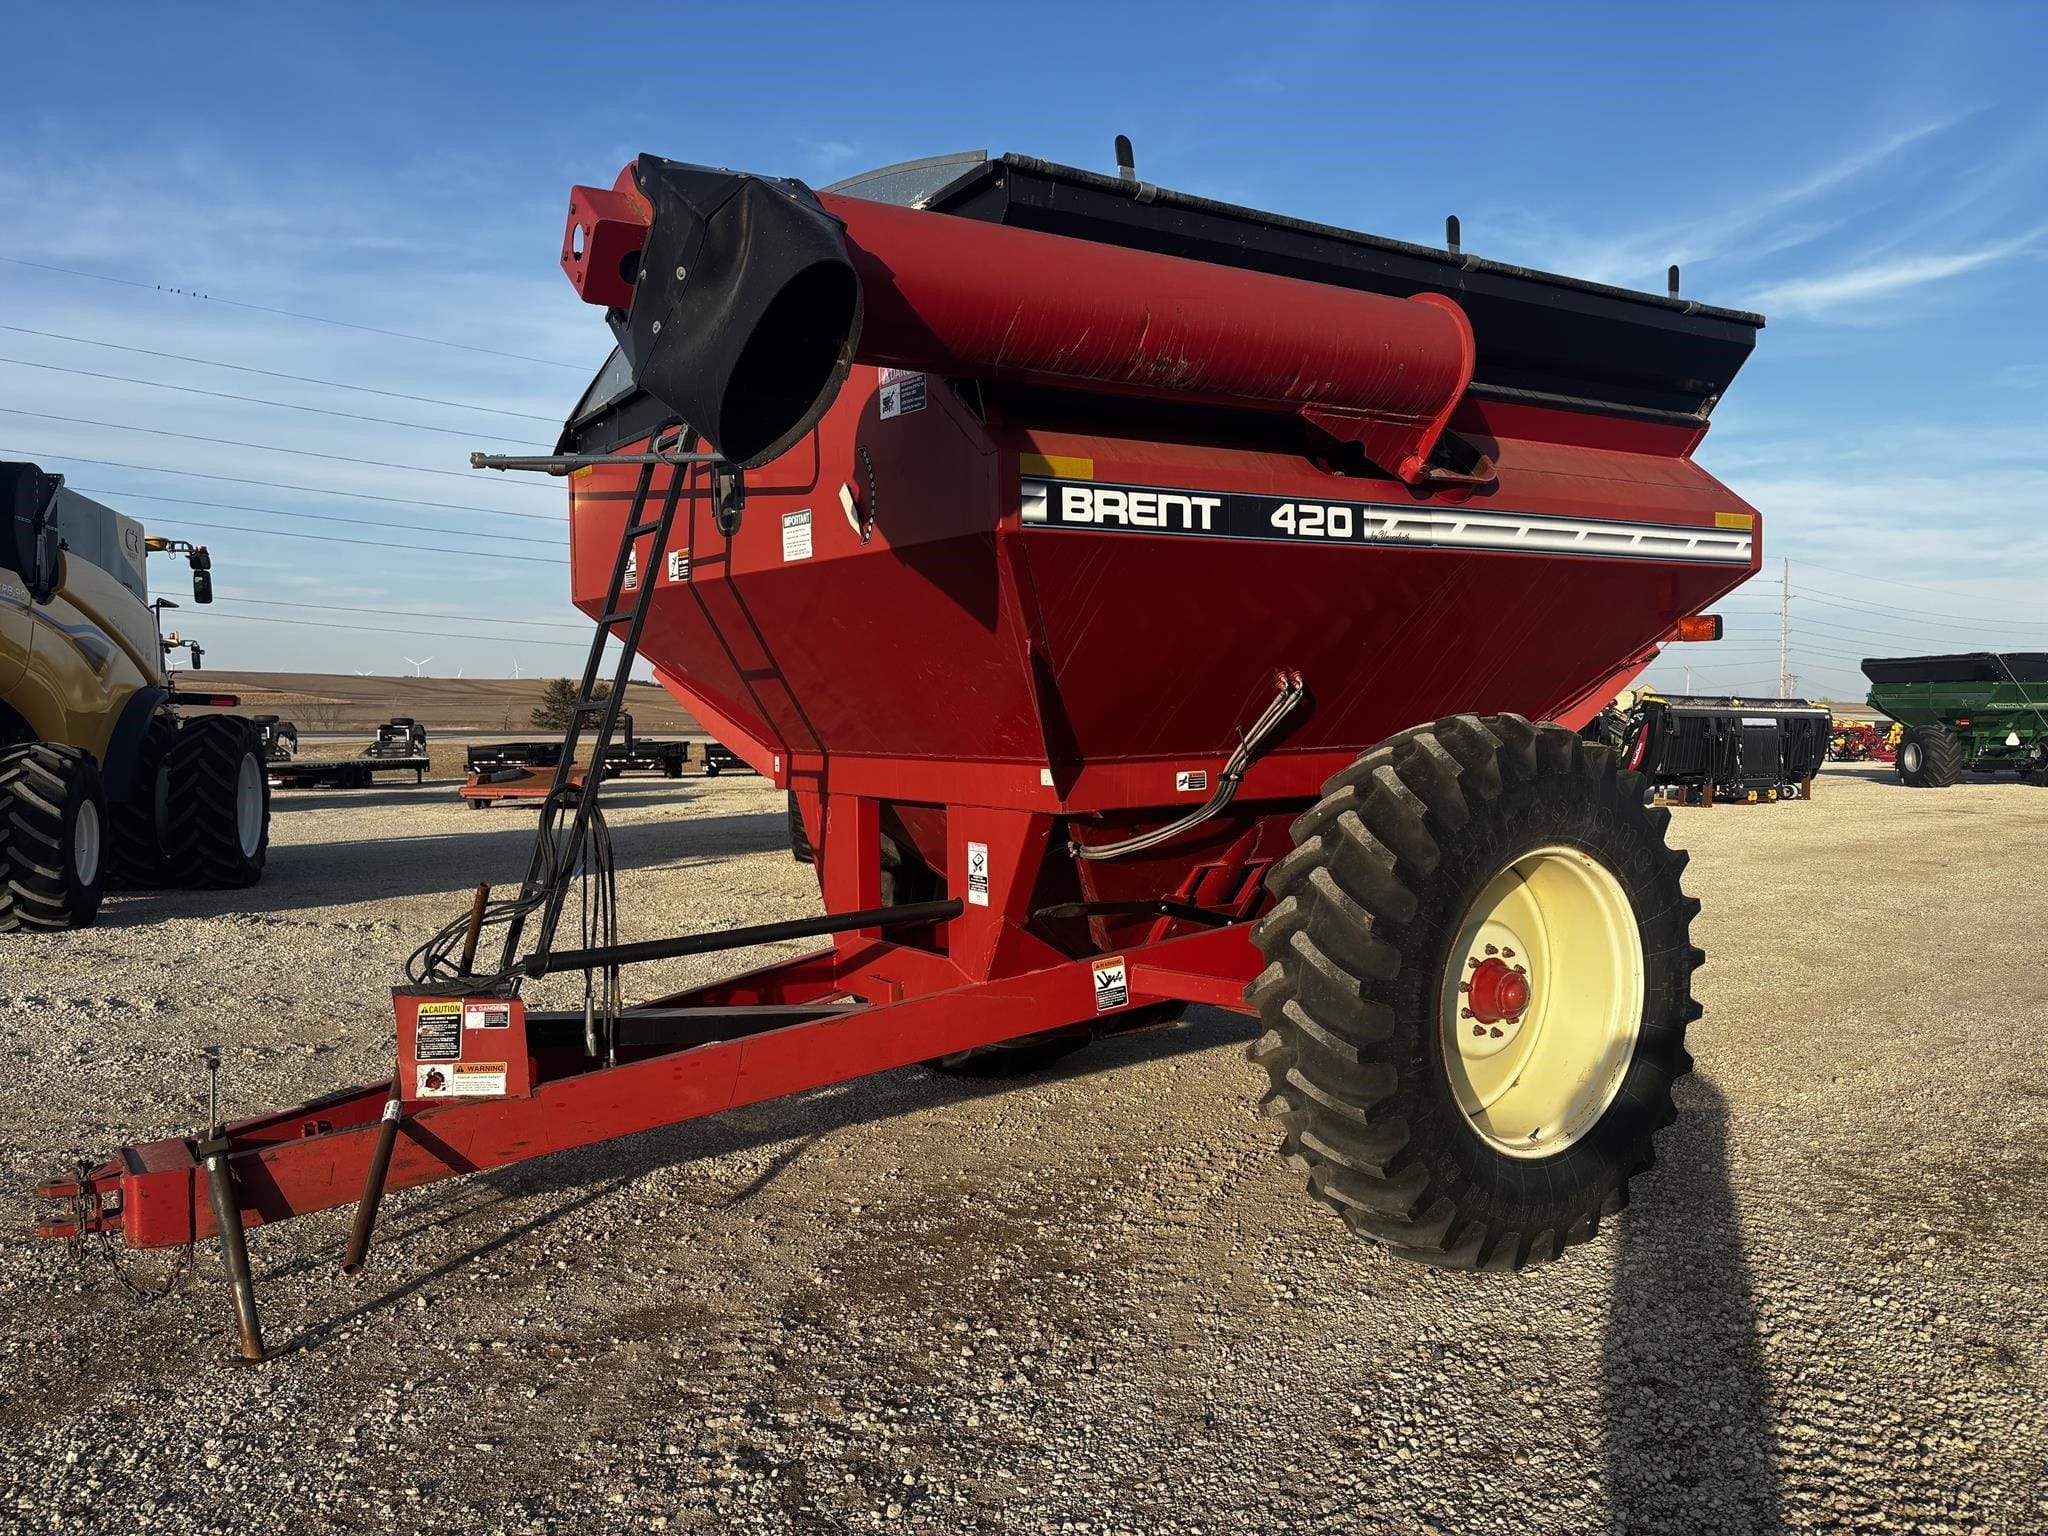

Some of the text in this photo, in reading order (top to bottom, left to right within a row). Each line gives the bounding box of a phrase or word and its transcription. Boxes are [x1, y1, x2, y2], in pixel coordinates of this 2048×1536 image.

[1061, 486, 1221, 530] BRENT
[783, 512, 810, 527] IMPORTANT
[1270, 503, 1353, 538] 420
[428, 1004, 461, 1014] CAUTION
[467, 1064, 504, 1072] WARNING
